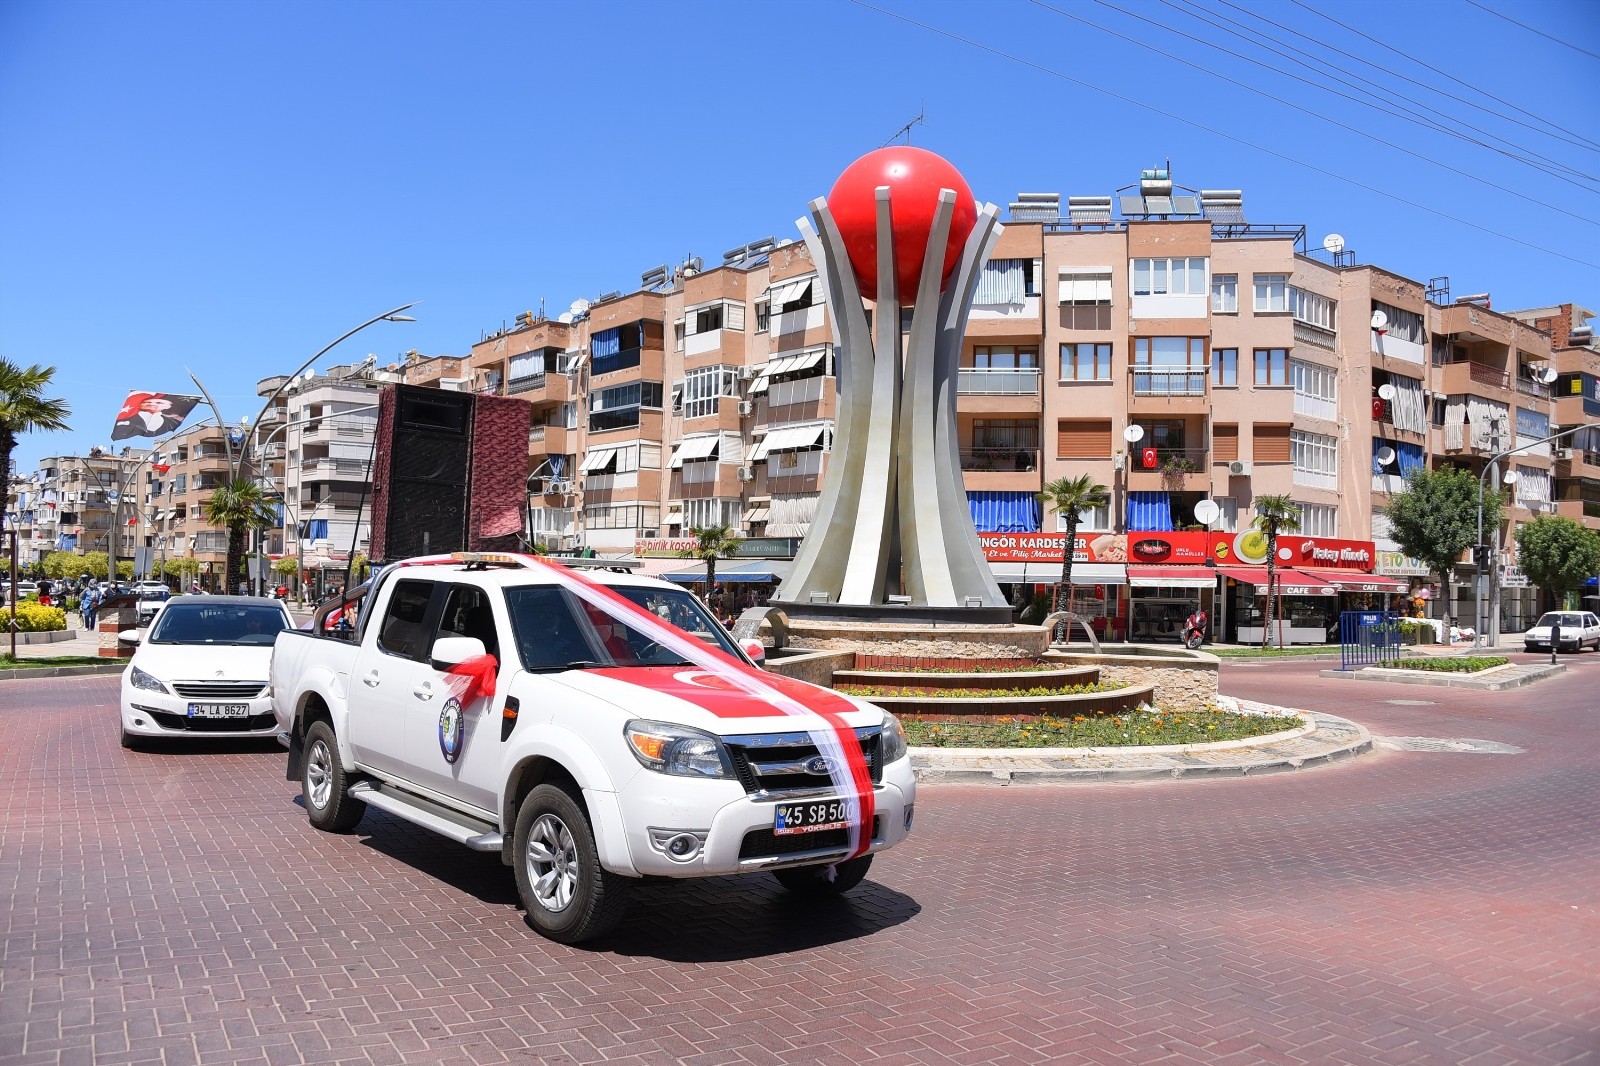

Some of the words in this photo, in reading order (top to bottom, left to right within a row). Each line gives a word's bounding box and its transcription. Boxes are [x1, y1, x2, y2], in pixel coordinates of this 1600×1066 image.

[1020, 537, 1087, 550] KARDEŞER
[1031, 549, 1063, 558] Market
[1312, 547, 1340, 563] Hatay
[1286, 587, 1309, 595] CAFE
[194, 705, 205, 715] 34
[209, 705, 221, 715] LA
[224, 705, 247, 715] 8627
[813, 761, 832, 771] Ford
[785, 806, 803, 825] 45
[808, 805, 826, 823] SB
